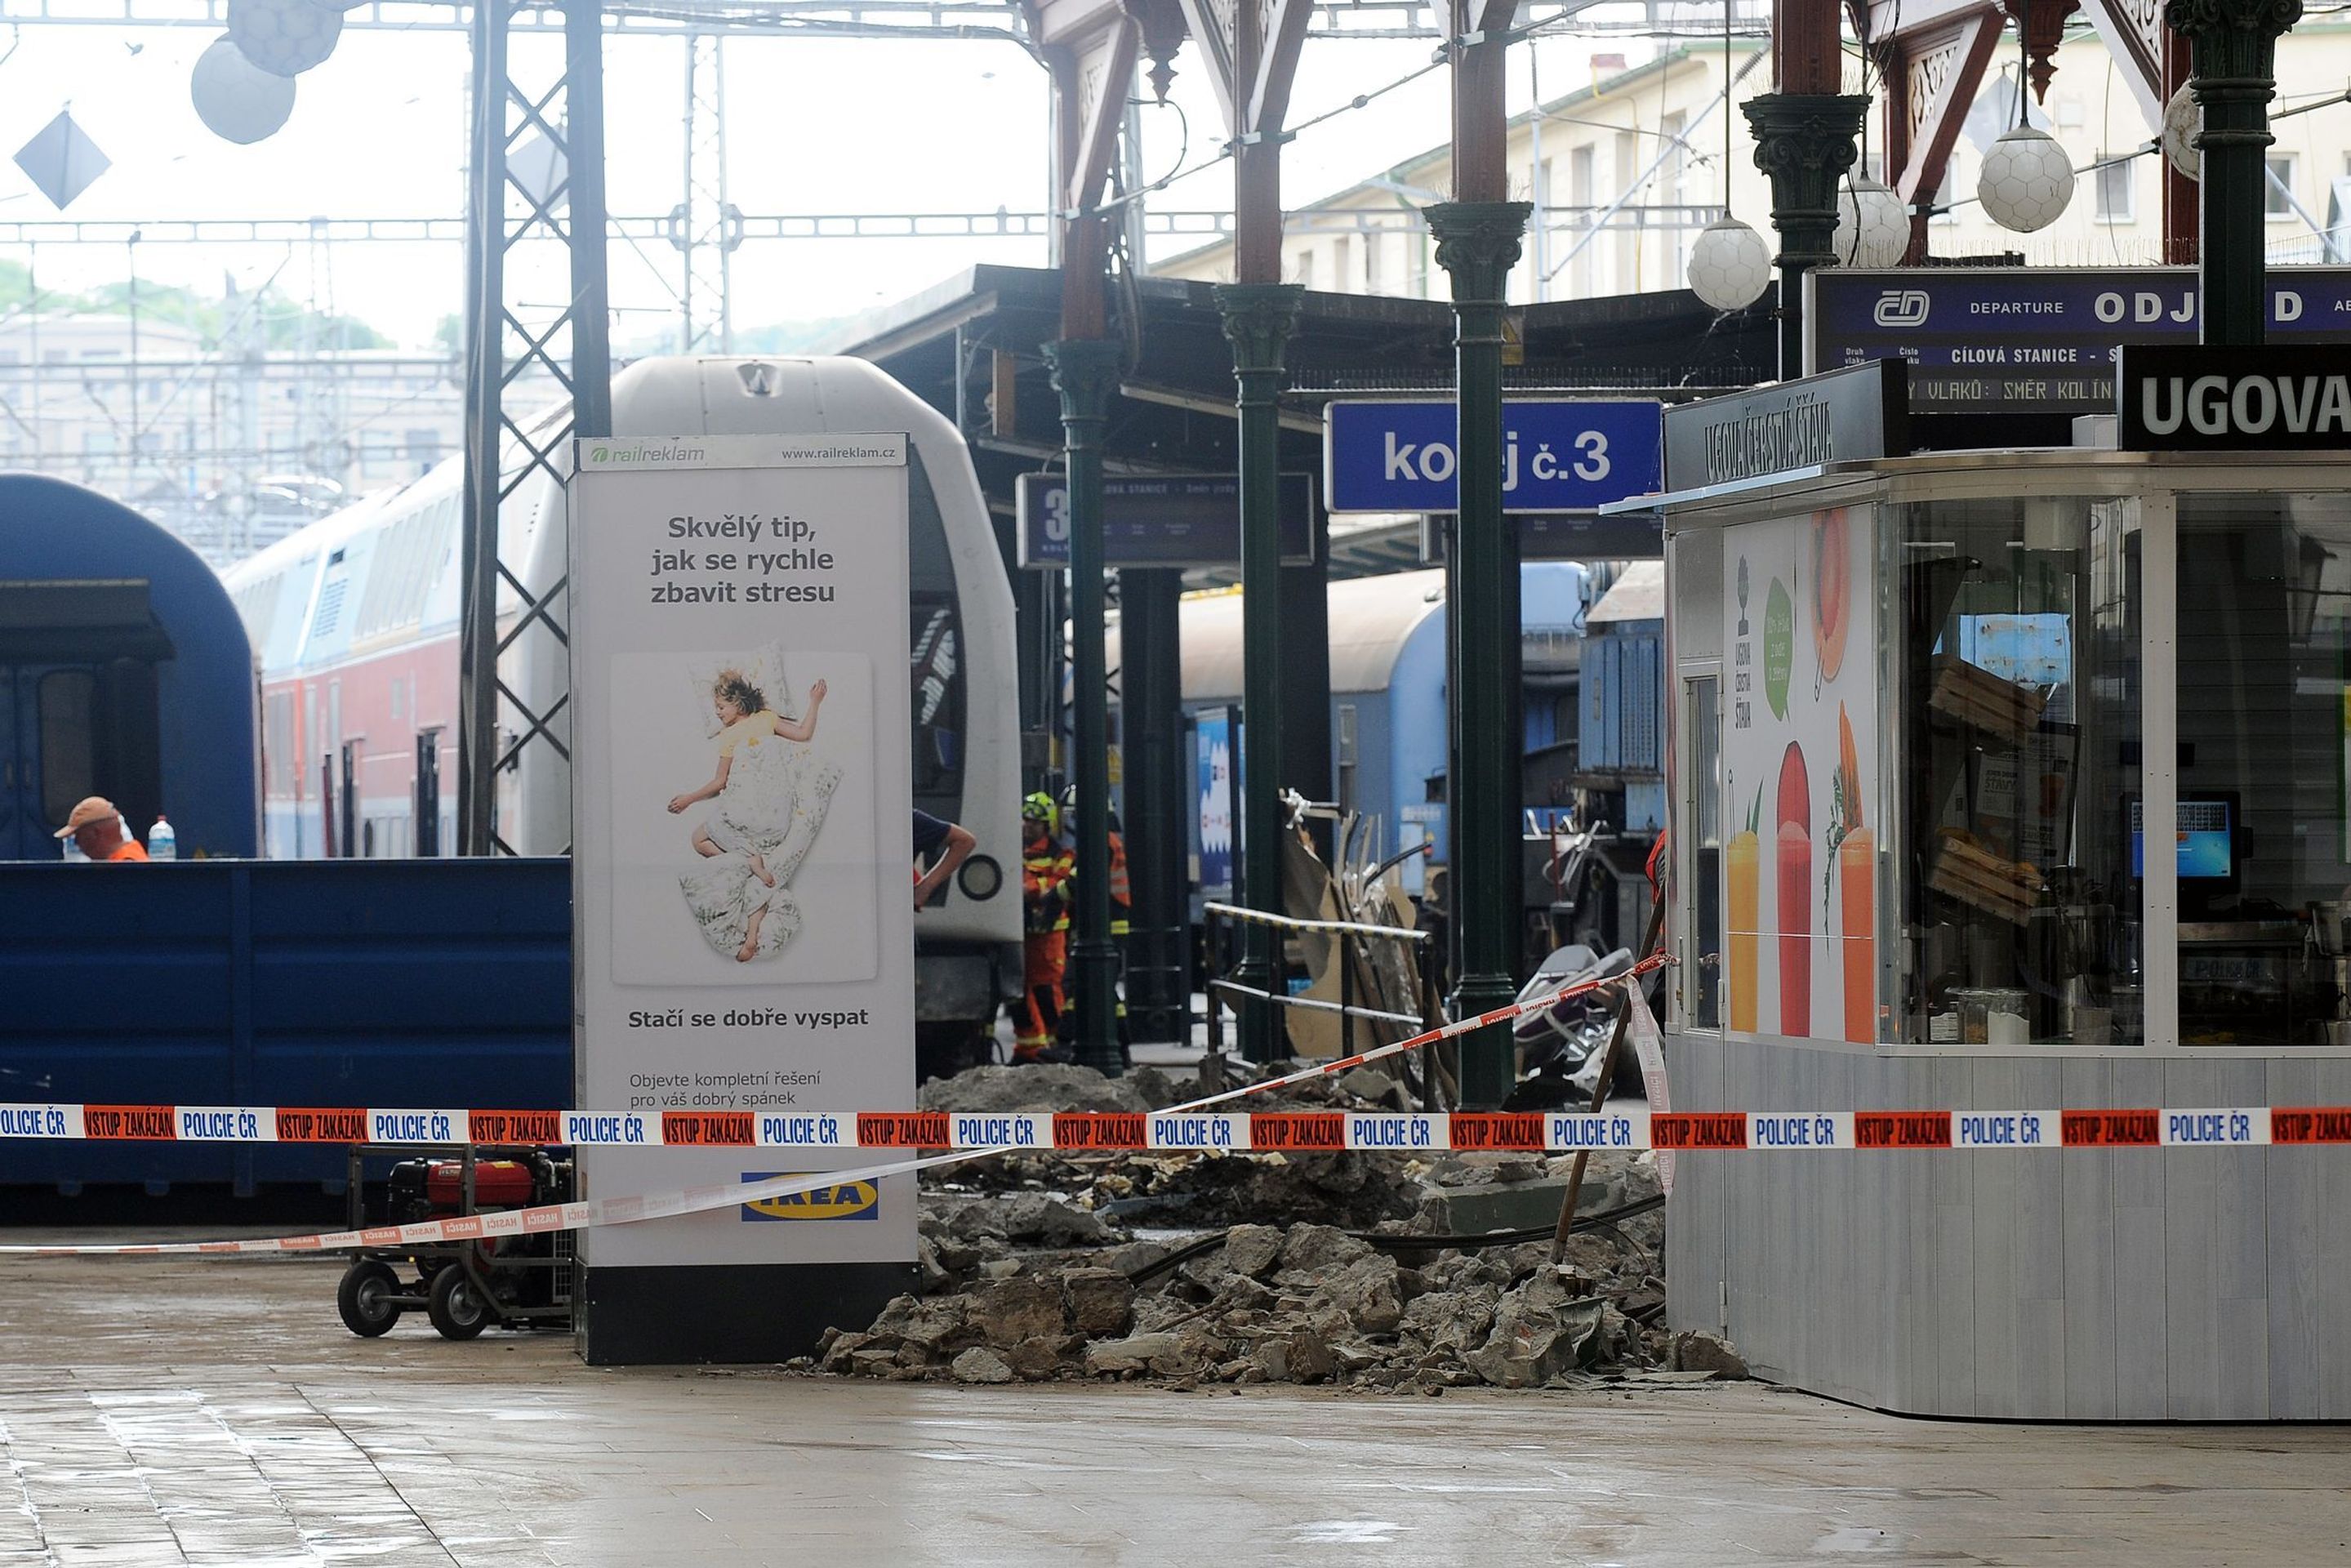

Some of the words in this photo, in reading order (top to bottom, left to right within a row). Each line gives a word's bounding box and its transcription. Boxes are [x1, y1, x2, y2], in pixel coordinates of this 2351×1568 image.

[1970, 301, 2064, 314] DEPARTURE
[2094, 292, 2303, 323] ODJD
[1846, 347, 1864, 356] Druh
[1899, 346, 1919, 356] Číslo
[1951, 346, 2006, 363] CÍLOVÁ
[2014, 349, 2077, 363] STANICE
[2003, 379, 2046, 400] SMĚR
[2057, 378, 2112, 400] KOLÍN
[2142, 375, 2351, 435] UGOVA
[1704, 421, 1745, 483] UGOVA
[1796, 392, 1834, 467] ŠŤÁVA
[612, 445, 705, 463] railreklam
[781, 447, 896, 460] www.railreklam.cz
[1385, 430, 1518, 492] koj
[1045, 488, 1070, 541] 3
[668, 514, 763, 543] Skvělý
[771, 516, 817, 542] tip,
[651, 550, 696, 577] jak
[705, 554, 737, 571] se
[747, 549, 835, 575] rychle
[651, 581, 737, 604] zbavit
[746, 583, 835, 603] stresu
[628, 1008, 684, 1028] Stačí
[691, 1012, 716, 1027] se
[724, 1008, 788, 1027] dobře
[795, 1009, 869, 1029] vyspat
[630, 1073, 689, 1089] Objevte
[695, 1071, 769, 1089] kompletní
[775, 1070, 822, 1085] řešení
[630, 1094, 656, 1109] pro
[661, 1090, 687, 1106] váš
[692, 1090, 735, 1109] dobrý
[741, 1090, 796, 1108] spánek
[0, 1110, 42, 1135] OLICIE
[47, 1104, 65, 1135] ČR
[84, 1111, 120, 1137] VSTUP
[124, 1106, 173, 1137] ZAKÁZÁN
[184, 1113, 234, 1138] POLICIE
[238, 1107, 257, 1138] ČR
[277, 1114, 313, 1140] VSTUP
[317, 1109, 366, 1140] ZAKÁZÁN
[376, 1116, 427, 1140] POLICIE
[432, 1110, 450, 1140] ČR
[470, 1116, 506, 1142] VSTUP
[510, 1111, 559, 1142] ZAKÁZÁN
[570, 1117, 619, 1142] POLICIE
[625, 1111, 643, 1142] ČR
[663, 1118, 700, 1143] VSTUP
[704, 1112, 753, 1143] ZAKÁZÁN
[764, 1119, 813, 1143] POLICIE
[819, 1113, 838, 1143] ČR
[858, 1119, 895, 1145] VSTUP
[899, 1114, 948, 1145] ZAKÁZÁN
[960, 1120, 1009, 1145] POLICIE
[1015, 1114, 1033, 1145] ČR
[1054, 1120, 1091, 1146] VSTUP
[1095, 1114, 1145, 1146] ZAKÁZÁN
[1156, 1120, 1206, 1145] POLICIE
[1212, 1114, 1231, 1145] ČR
[1251, 1120, 1289, 1146] VSTUP
[1293, 1114, 1343, 1146] ZAKÁZÁN
[1355, 1120, 1405, 1145] POLICIE
[1411, 1114, 1429, 1145] ČR
[1450, 1120, 1488, 1146] VSTUP
[1492, 1114, 1543, 1146] ZAKÁZÁN
[1555, 1120, 1605, 1145] POLICIE
[1612, 1114, 1630, 1145] ČR
[1652, 1119, 1690, 1145] VSTUP
[1694, 1114, 1746, 1145] ZAKÁZÁN
[1757, 1119, 1808, 1144] POLICIE
[1814, 1113, 1834, 1144] ČR
[1855, 1119, 1894, 1144] VSTUP
[1962, 1118, 2015, 1143] POLICIE
[2020, 1112, 2039, 1143] ČR
[2062, 1116, 2101, 1143] VSTUP
[2171, 1115, 2224, 1141] POLICIE
[2230, 1109, 2250, 1141] ČR
[2272, 1114, 2311, 1142] VSTUP
